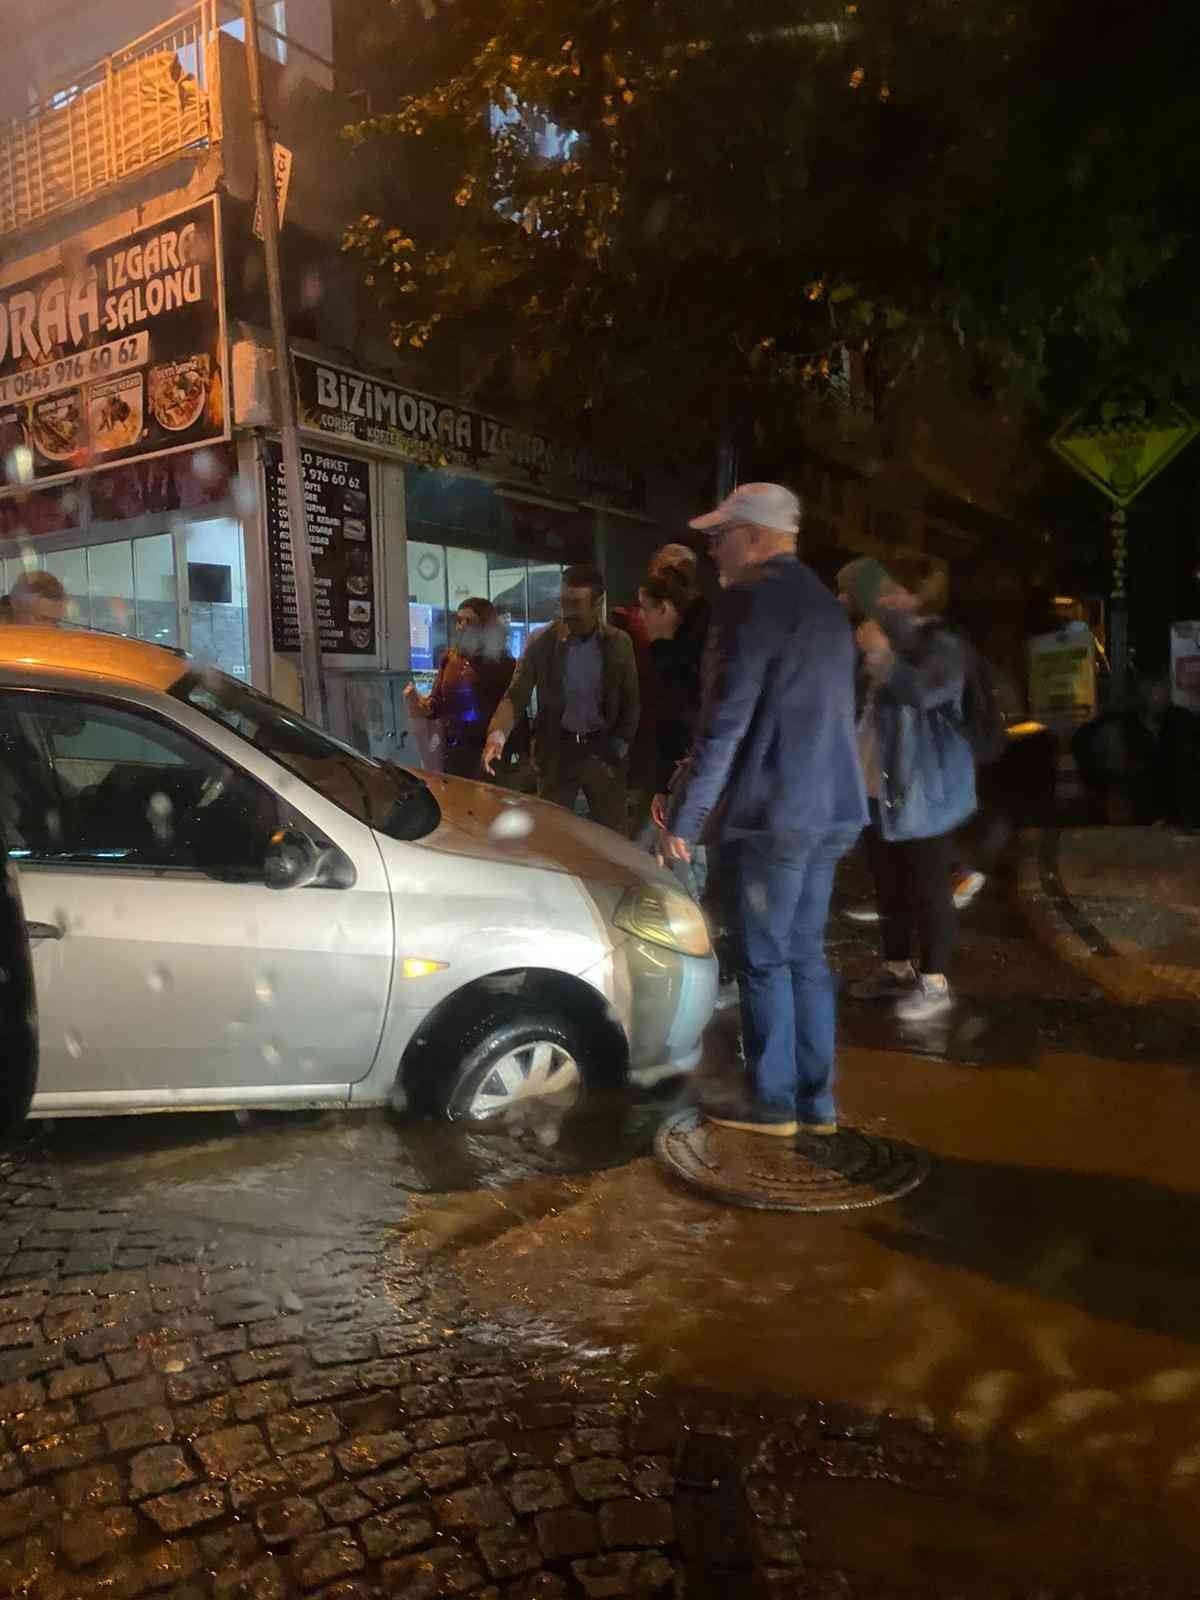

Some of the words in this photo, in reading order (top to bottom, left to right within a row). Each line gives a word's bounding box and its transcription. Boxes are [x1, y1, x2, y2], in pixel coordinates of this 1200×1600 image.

[0, 264, 100, 364] RAA
[104, 264, 201, 332] SALONU
[55, 356, 84, 383] 976
[89, 347, 112, 373] 60
[118, 339, 139, 365] 62
[309, 468, 329, 482] 976
[331, 474, 346, 487] 60
[349, 477, 361, 491] 62
[316, 455, 349, 474] PAKET
